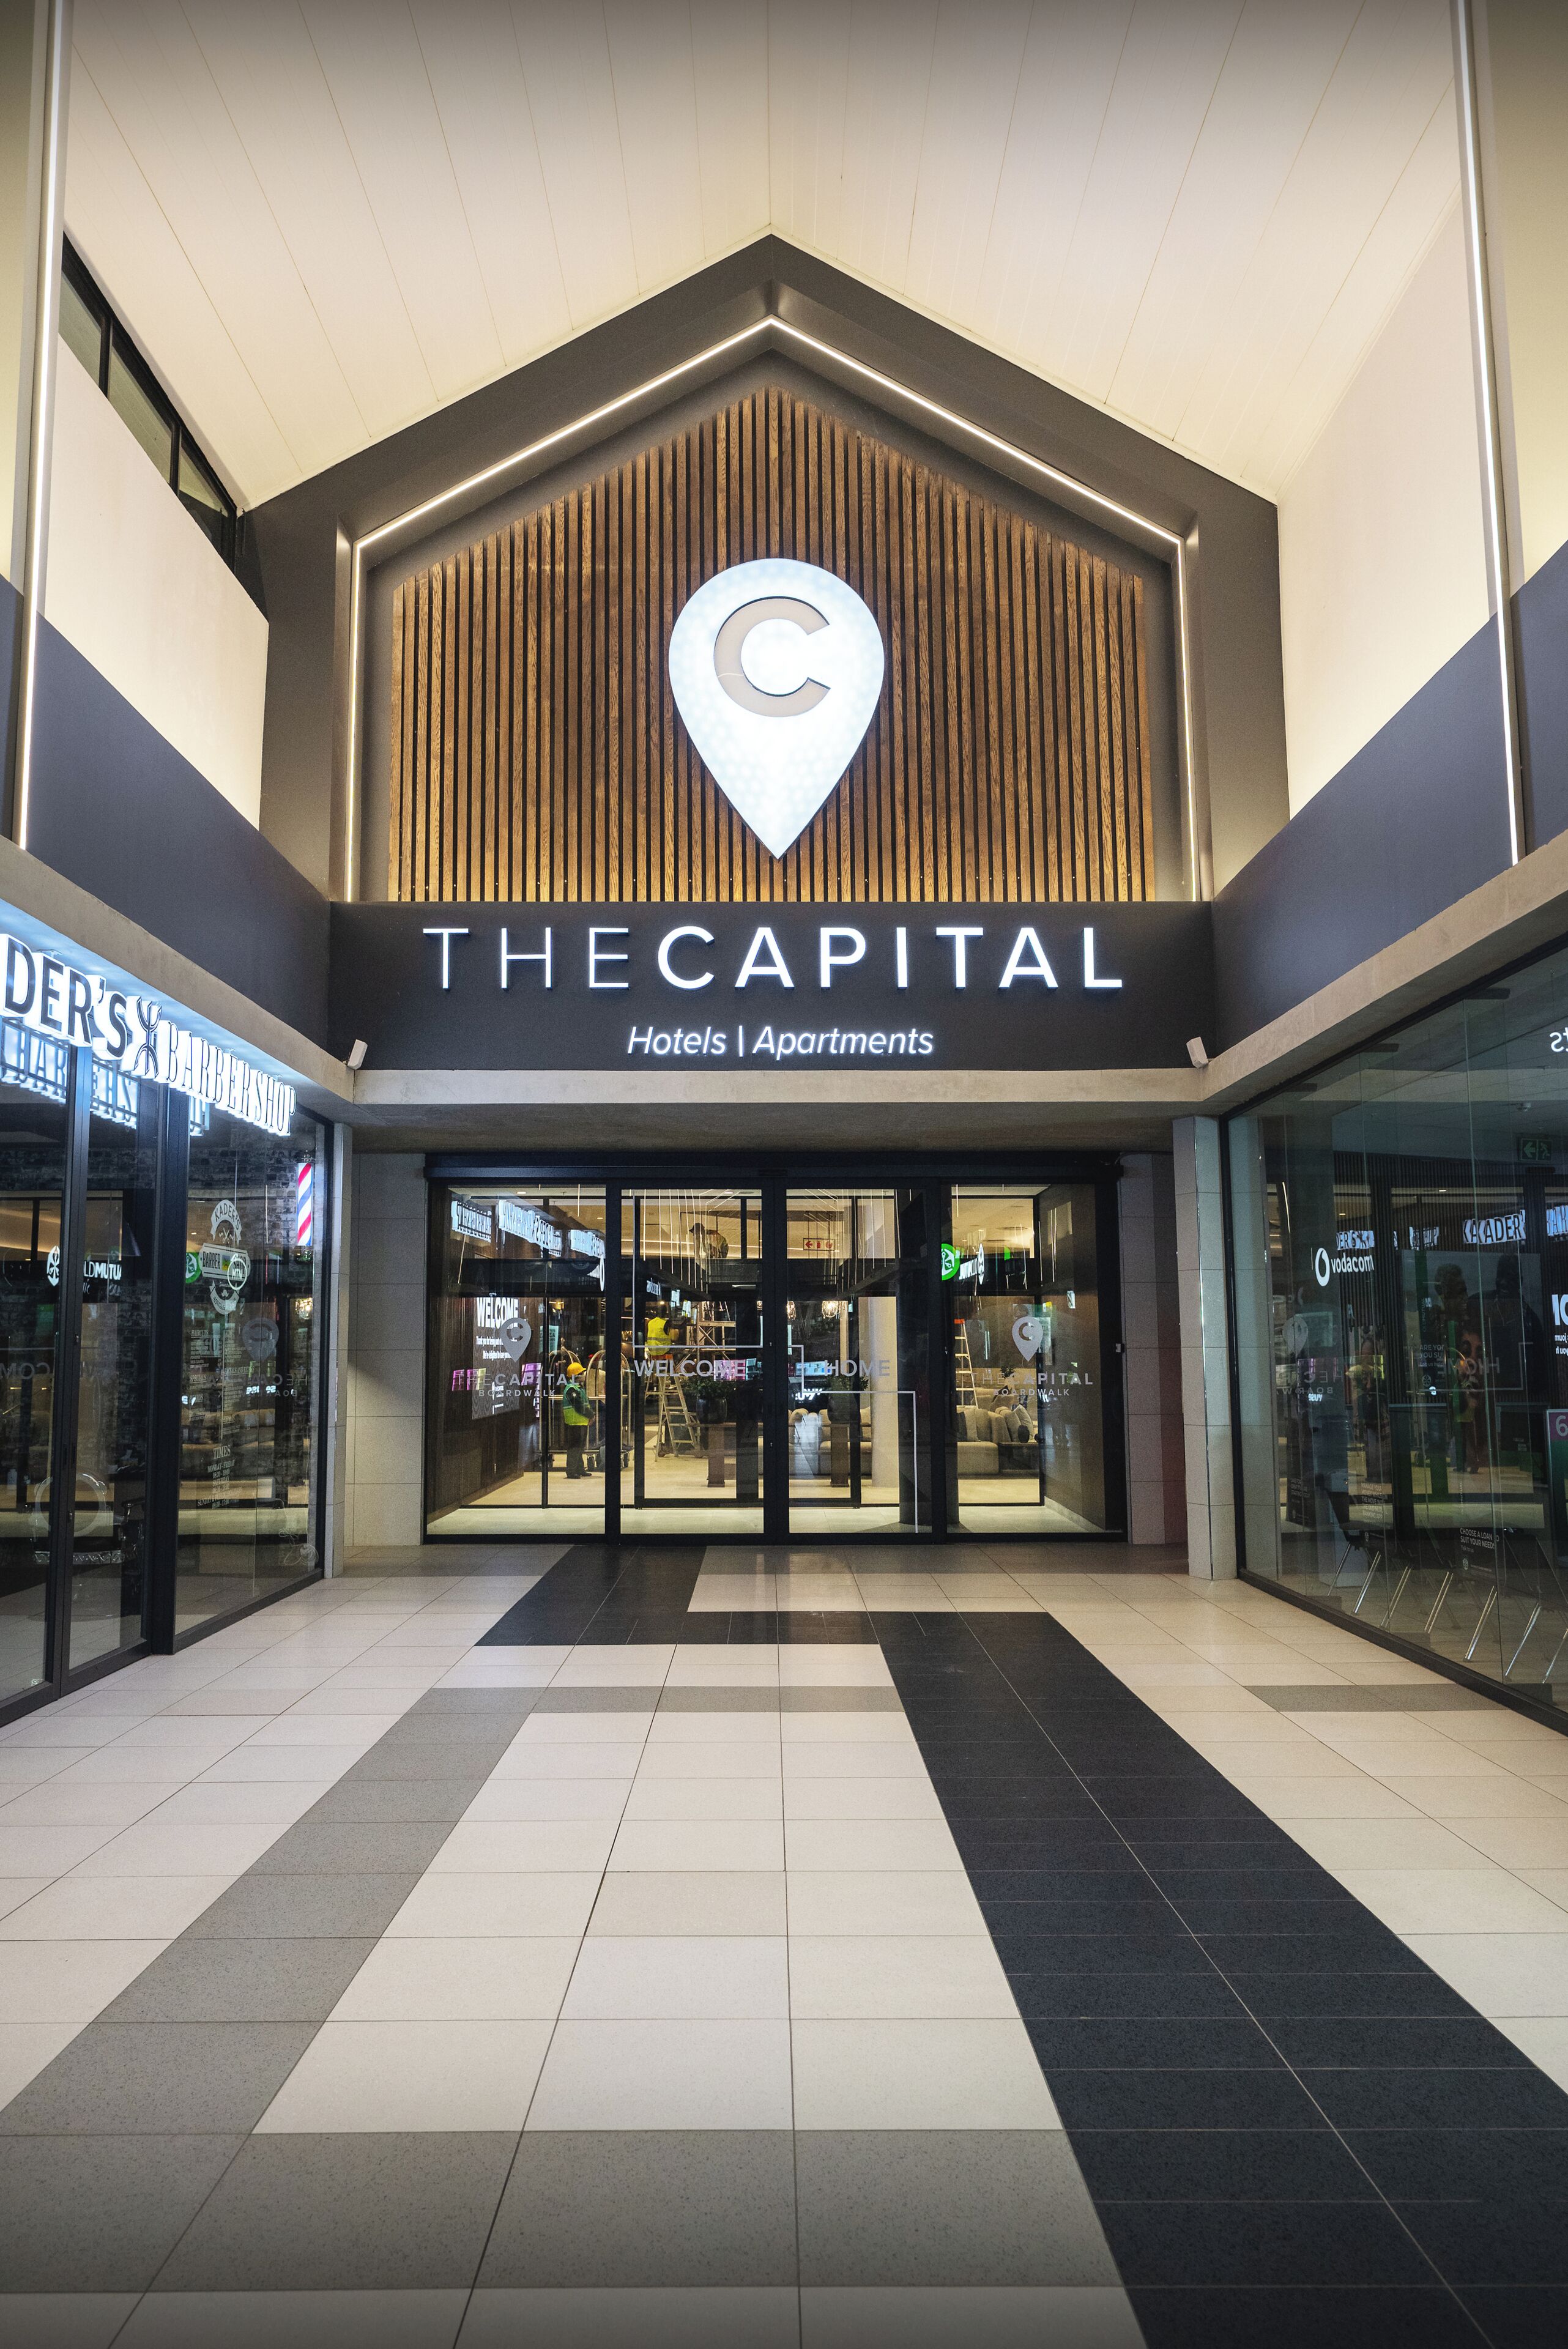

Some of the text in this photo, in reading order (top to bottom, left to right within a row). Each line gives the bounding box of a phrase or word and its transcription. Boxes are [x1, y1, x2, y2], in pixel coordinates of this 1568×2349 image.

[628, 1026, 727, 1057] Hotels
[752, 1025, 934, 1061] Apartments
[203, 1251, 221, 1270] BARBER
[1331, 1252, 1375, 1274] vodacom
[84, 1261, 122, 1280] LDMUTUA
[477, 1297, 519, 1329] WELCOME
[634, 1360, 746, 1377] WELCOME
[825, 1359, 890, 1376] HOME
[213, 1445, 231, 1460] TIMES
[1460, 1527, 1476, 1537] CHOOSE
[1460, 1535, 1470, 1544] SUIT
[1470, 1538, 1481, 1547] YOUR
